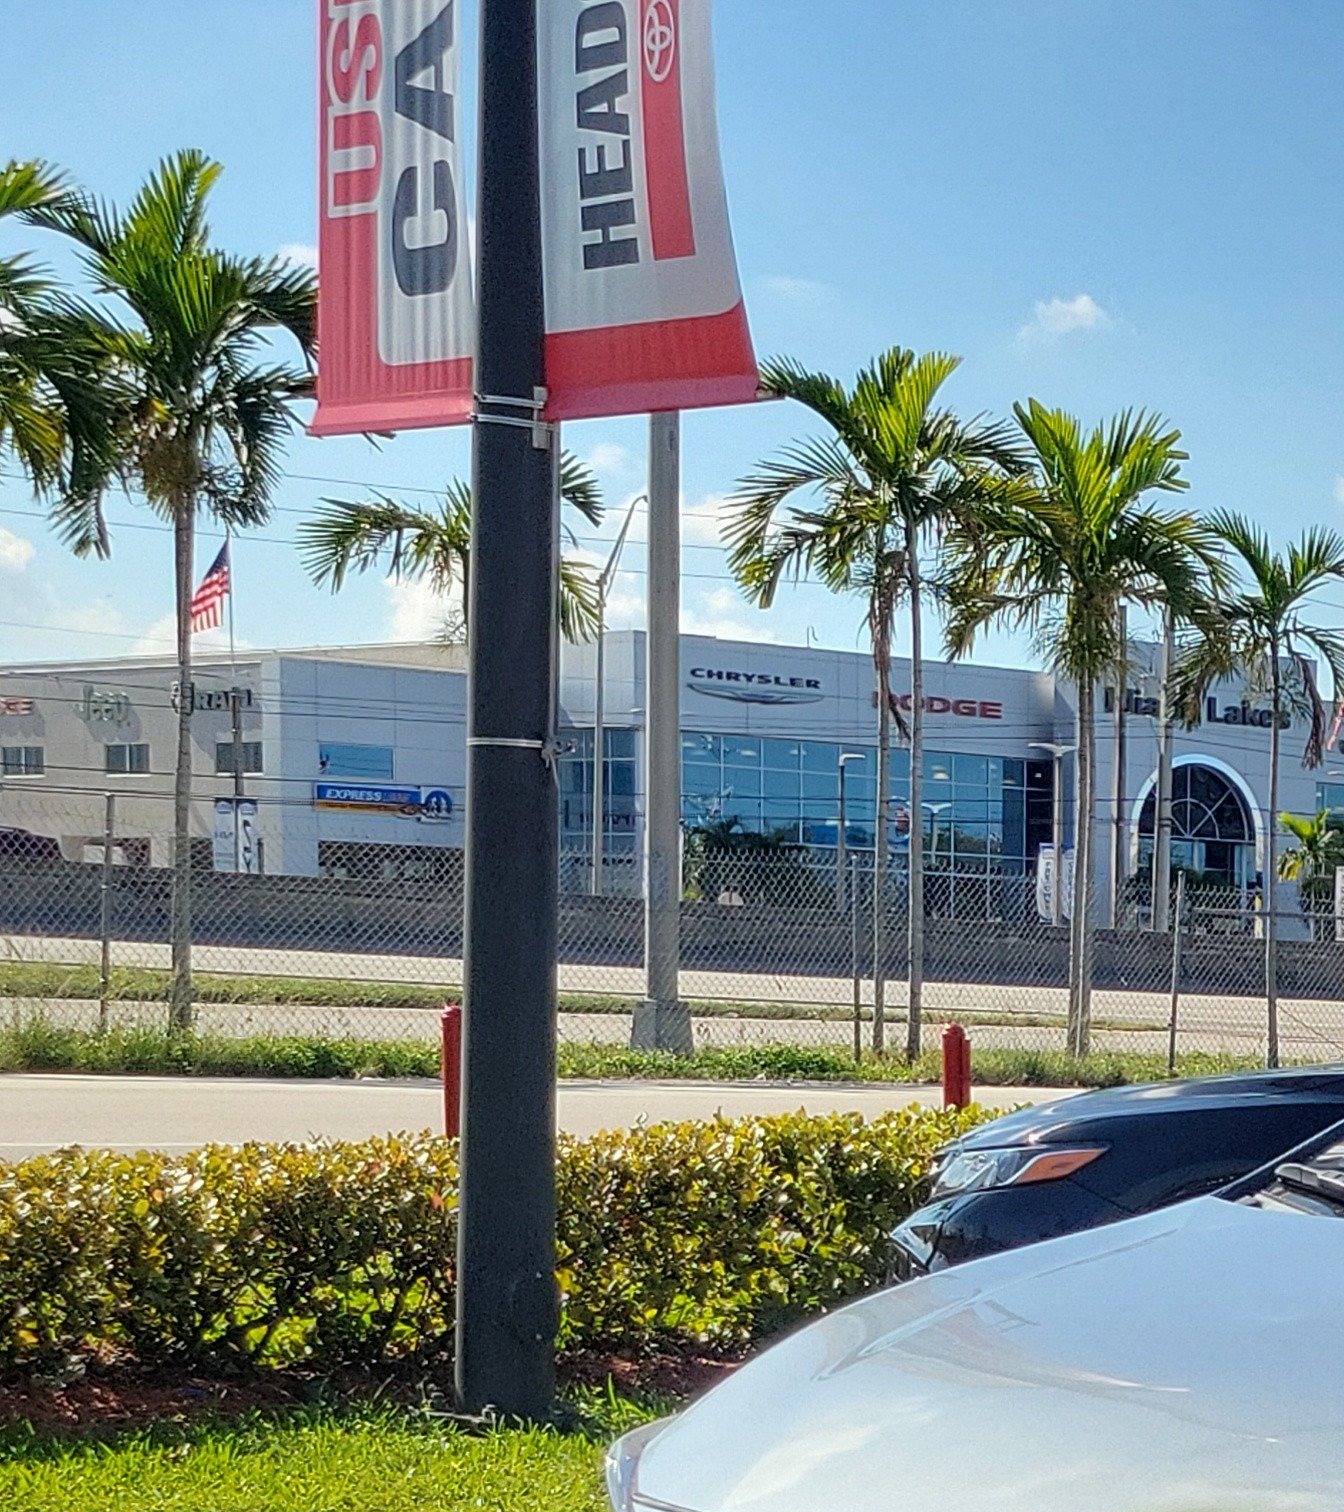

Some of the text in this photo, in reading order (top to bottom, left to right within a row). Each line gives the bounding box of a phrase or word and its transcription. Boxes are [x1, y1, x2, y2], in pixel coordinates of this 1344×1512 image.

[329, 0, 384, 213] US
[689, 667, 821, 691] CHRYSLER
[1206, 696, 1292, 730] Lakes
[325, 788, 383, 802] EXPRESS
